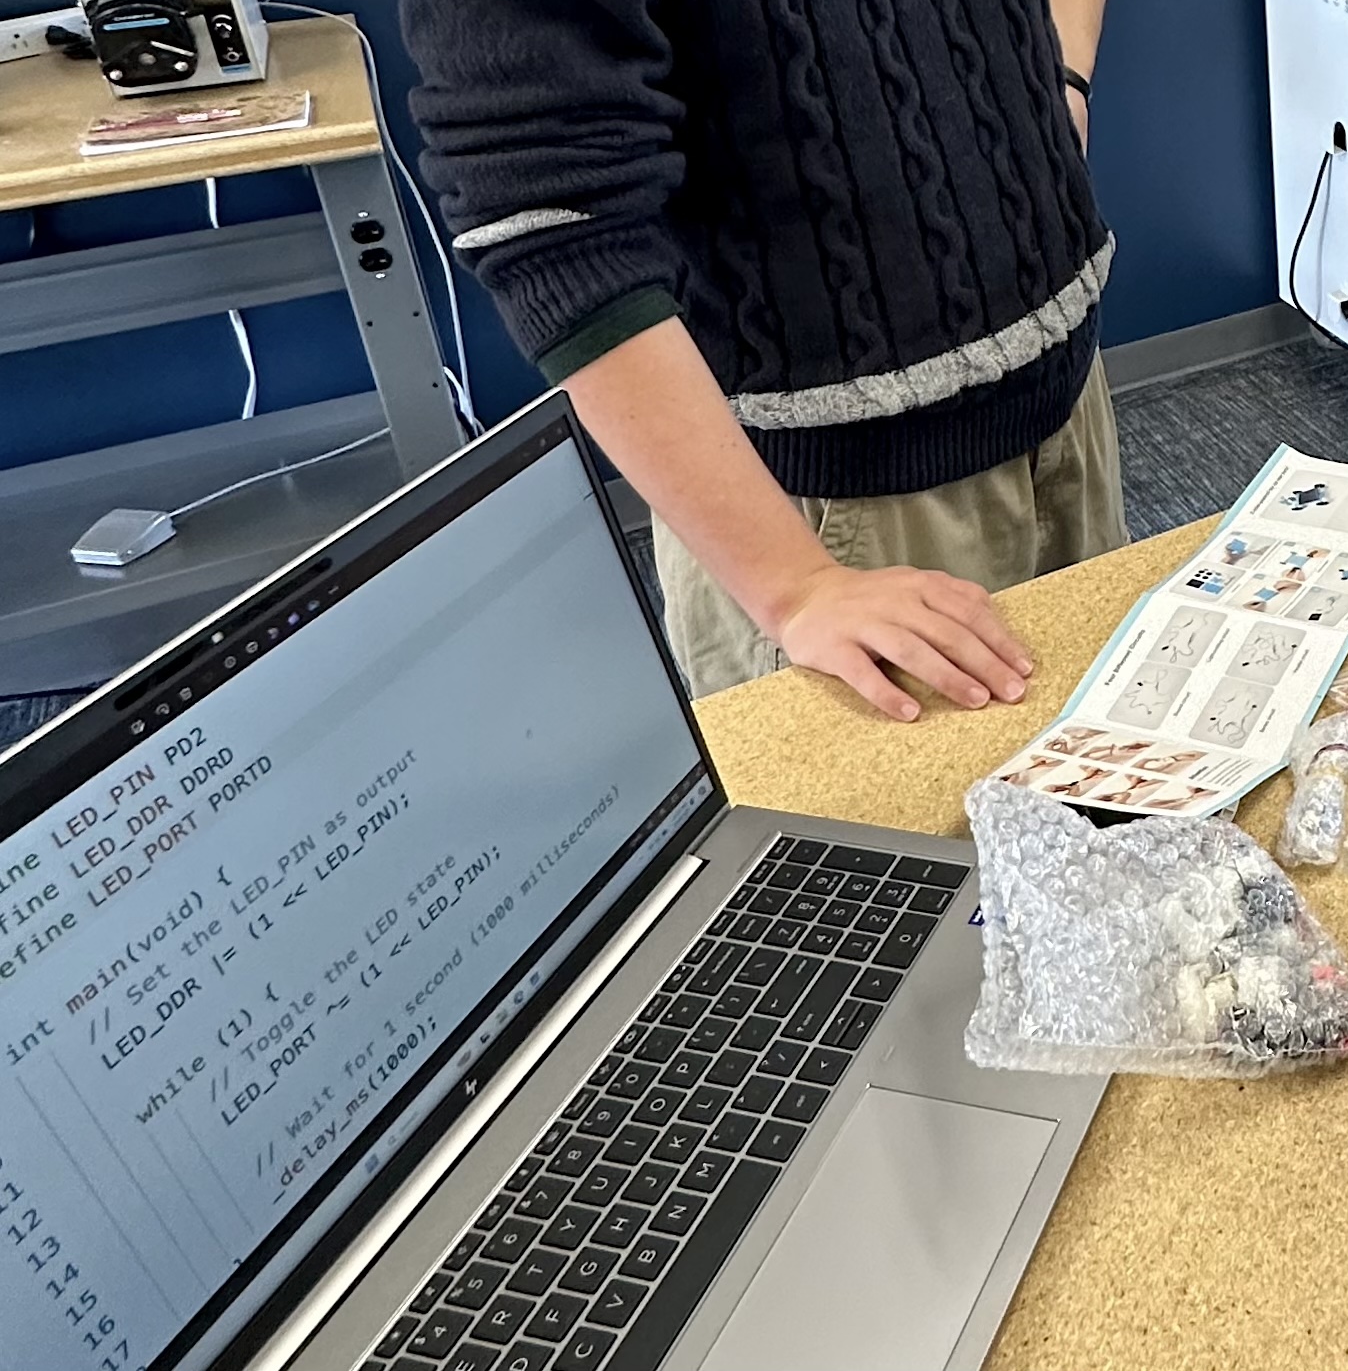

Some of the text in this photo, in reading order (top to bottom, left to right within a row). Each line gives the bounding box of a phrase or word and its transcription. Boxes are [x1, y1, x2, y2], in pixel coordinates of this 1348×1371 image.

[51, 764, 156, 849] LED_PIN
[163, 726, 207, 766] PD2
[69, 794, 174, 879] LED_DDR
[179, 746, 235, 795] DDRD
[87, 810, 199, 908] LED_PORT
[207, 755, 273, 813] PORTD
[126, 962, 171, 1006] Set
[180, 919, 222, 958] the
[229, 834, 317, 916] LED_PIN
[323, 810, 347, 835] as
[355, 749, 418, 808] output
[101, 976, 202, 1070] LED_DDR
[282, 882, 308, 908] <<
[314, 792, 409, 881] LED_PIN);
[240, 990, 316, 1063] Toggle
[323, 948, 359, 984] the
[364, 907, 398, 946] LED
[406, 855, 457, 907] state
[284, 1084, 335, 1140] Wait
[343, 1041, 376, 1078] for
[383, 1020, 398, 1038] 1
[405, 948, 464, 1017] second
[470, 896, 515, 947] (1000
[518, 784, 620, 897] milliseconds)
[5, 1018, 54, 1066] int
[65, 890, 204, 1015] main(void)
[220, 1023, 317, 1127] LED_PORT
[389, 933, 413, 958] <<
[417, 845, 501, 931] LED_PIN);
[135, 1055, 206, 1124] while
[217, 1009, 252, 1047] (1)
[675, 1062, 690, 1074] P
[625, 1073, 639, 1084] 0
[272, 1016, 437, 1205] _delay_ms(1000);
[650, 1098, 666, 1112] O
[696, 1098, 711, 1111] L
[597, 1110, 611, 1121] 9
[668, 1135, 688, 1150] K
[567, 1148, 582, 1160] 8
[695, 1162, 716, 1178] M
[590, 1177, 608, 1190] U
[645, 1176, 658, 1187] J
[535, 1190, 548, 1200] 7
[667, 1204, 688, 1220] N
[7, 1208, 43, 1245] 12
[559, 1218, 576, 1232] Y
[610, 1217, 629, 1232] H
[502, 1233, 519, 1245] 6
[27, 1236, 61, 1273] 13
[637, 1248, 657, 1264] B
[526, 1263, 544, 1276] T
[579, 1260, 598, 1276] G
[46, 1263, 80, 1300] 14
[467, 1278, 484, 1290] 5
[65, 1289, 97, 1326] 15
[606, 1293, 625, 1310] V
[491, 1310, 513, 1326] R
[544, 1308, 562, 1324] F
[83, 1315, 115, 1351] 16
[433, 1325, 448, 1338] 4
[574, 1342, 594, 1359] C
